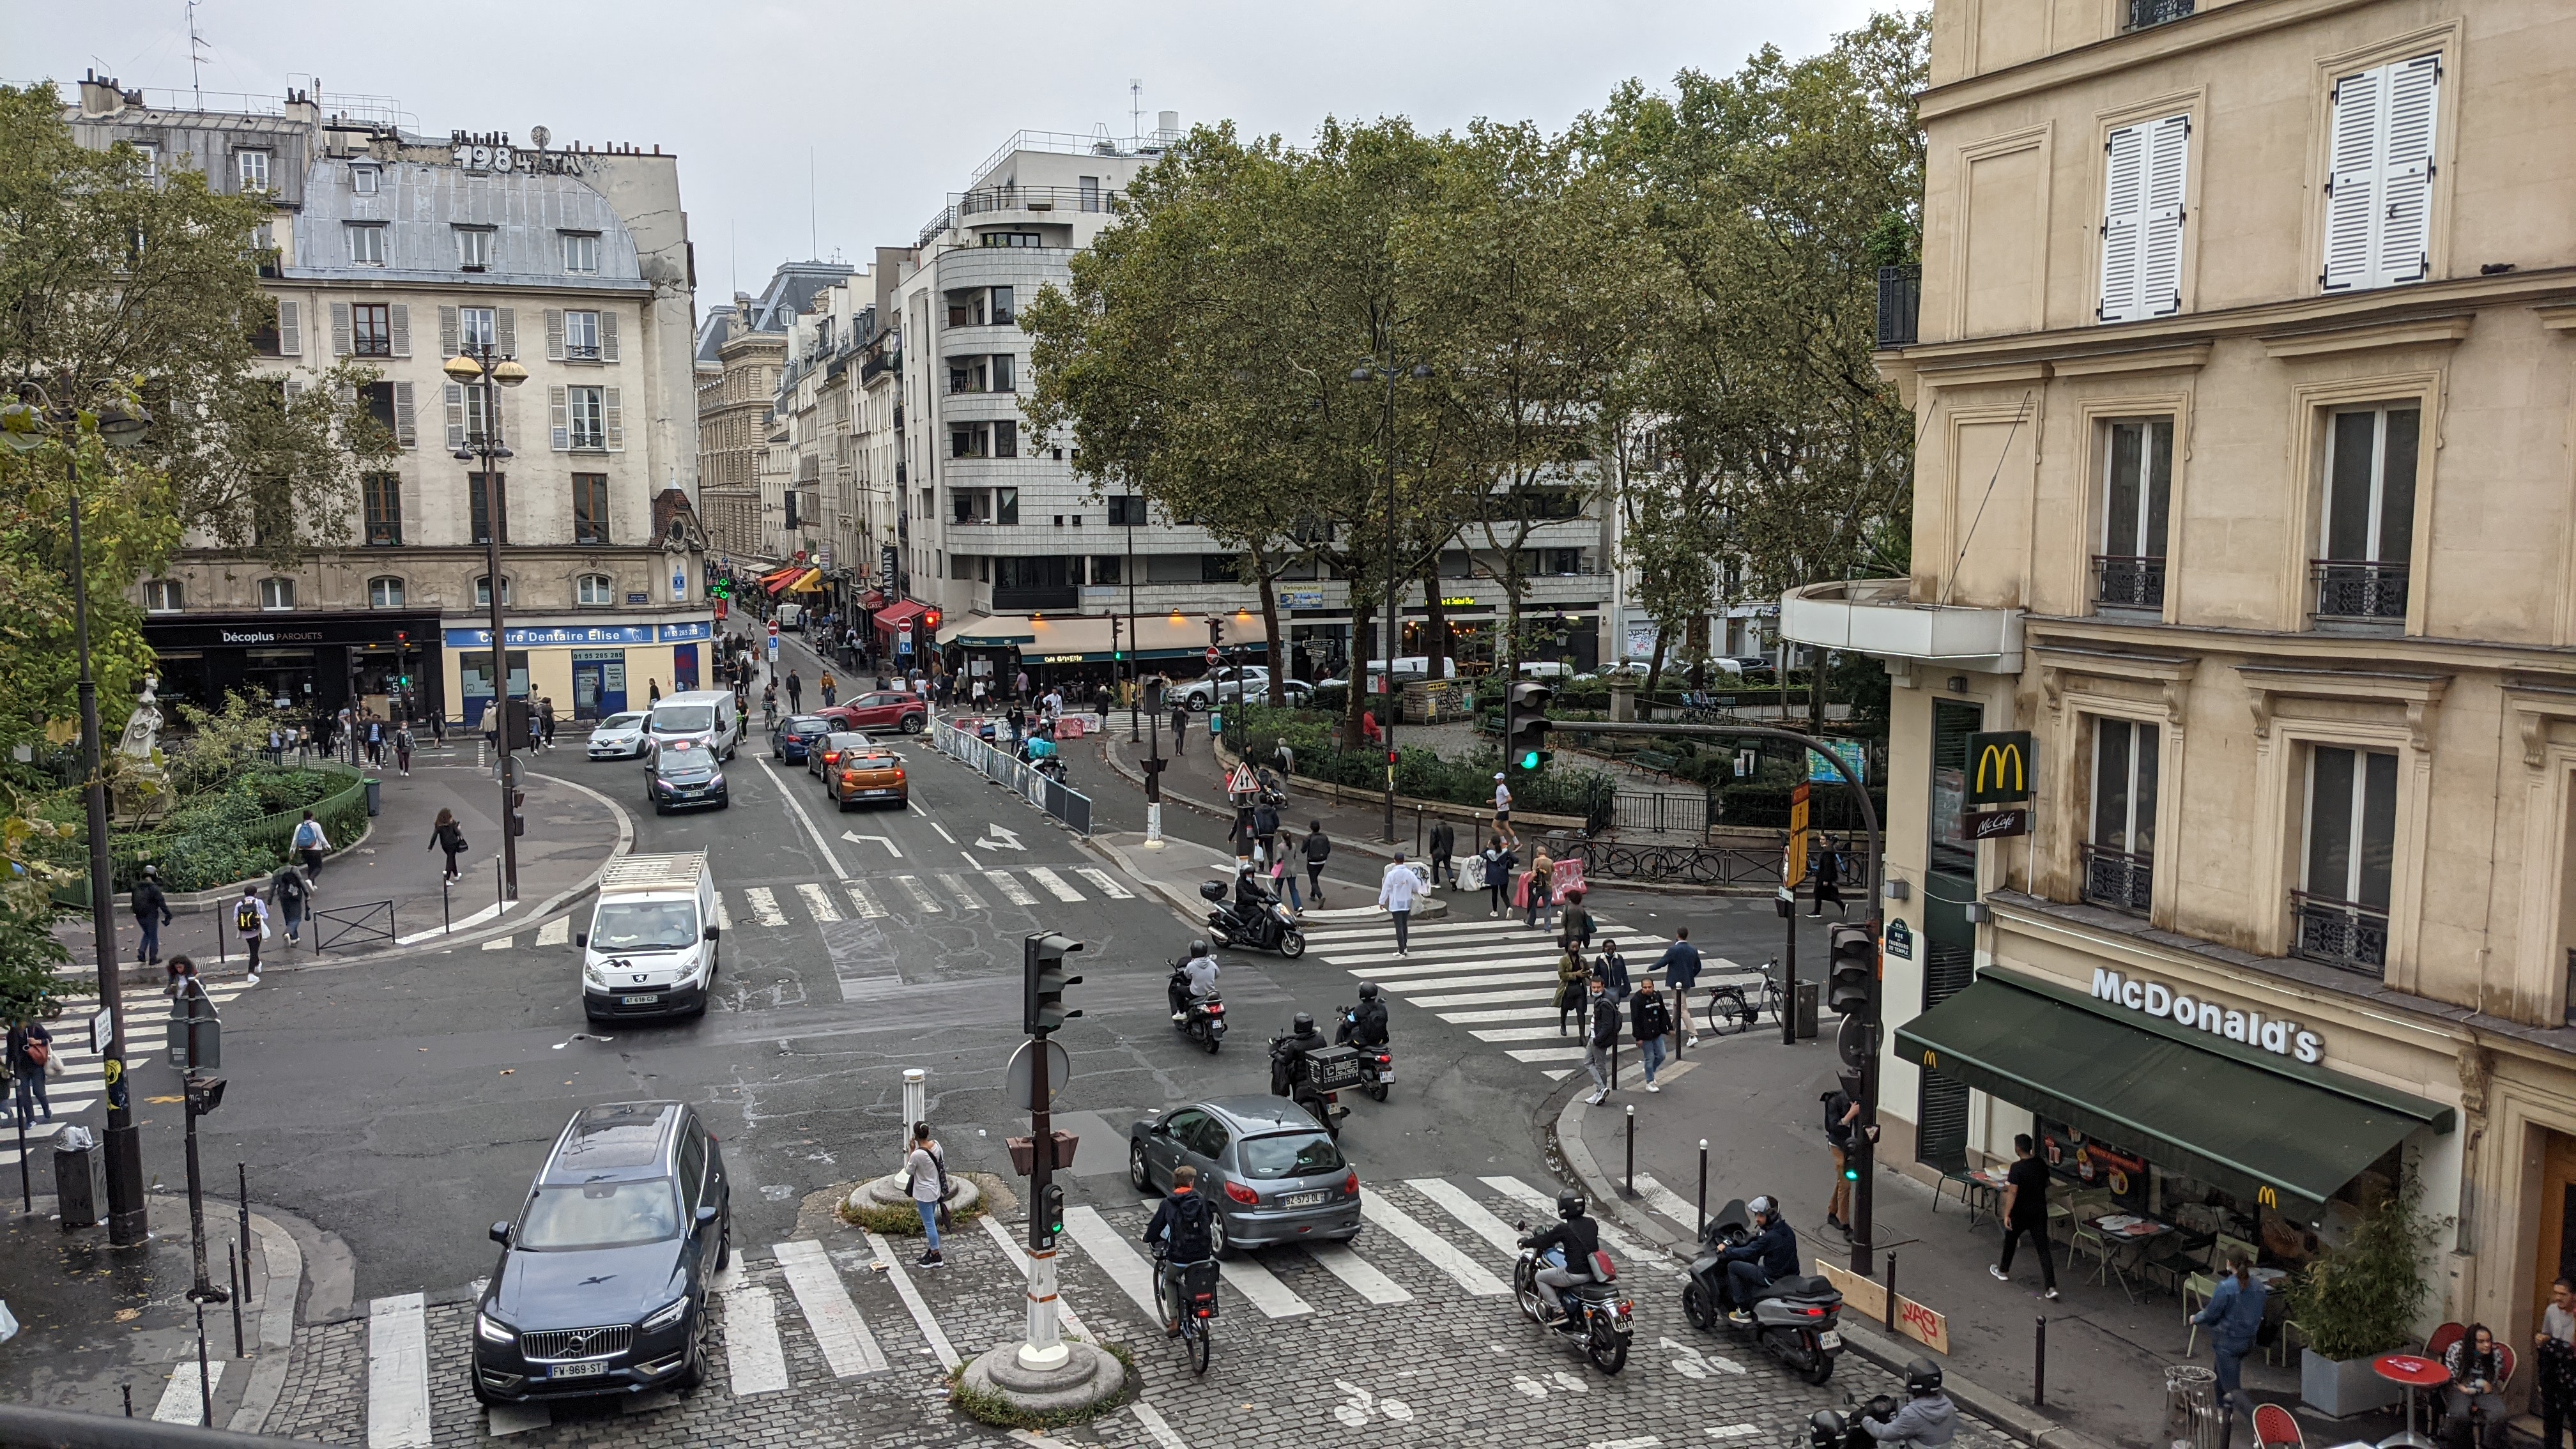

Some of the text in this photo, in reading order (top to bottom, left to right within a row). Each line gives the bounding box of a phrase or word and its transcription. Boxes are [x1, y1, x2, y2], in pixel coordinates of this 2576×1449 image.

[883, 551, 893, 597] MANDIN
[223, 631, 323, 643] Décoplus PARQUETS
[480, 631, 620, 643] Ctre Dentaire Elise
[386, 681, 415, 693] -5%
[1977, 812, 2015, 836] McCafé
[1894, 931, 1904, 940] RUE
[1888, 939, 1909, 950] FAUBOURG
[1894, 946, 1909, 956] TEMPLE
[2090, 967, 2324, 1064] McDonald's
[1285, 1193, 1320, 1204] BZ-573-DL
[553, 1363, 602, 1377] FW-969-ST
